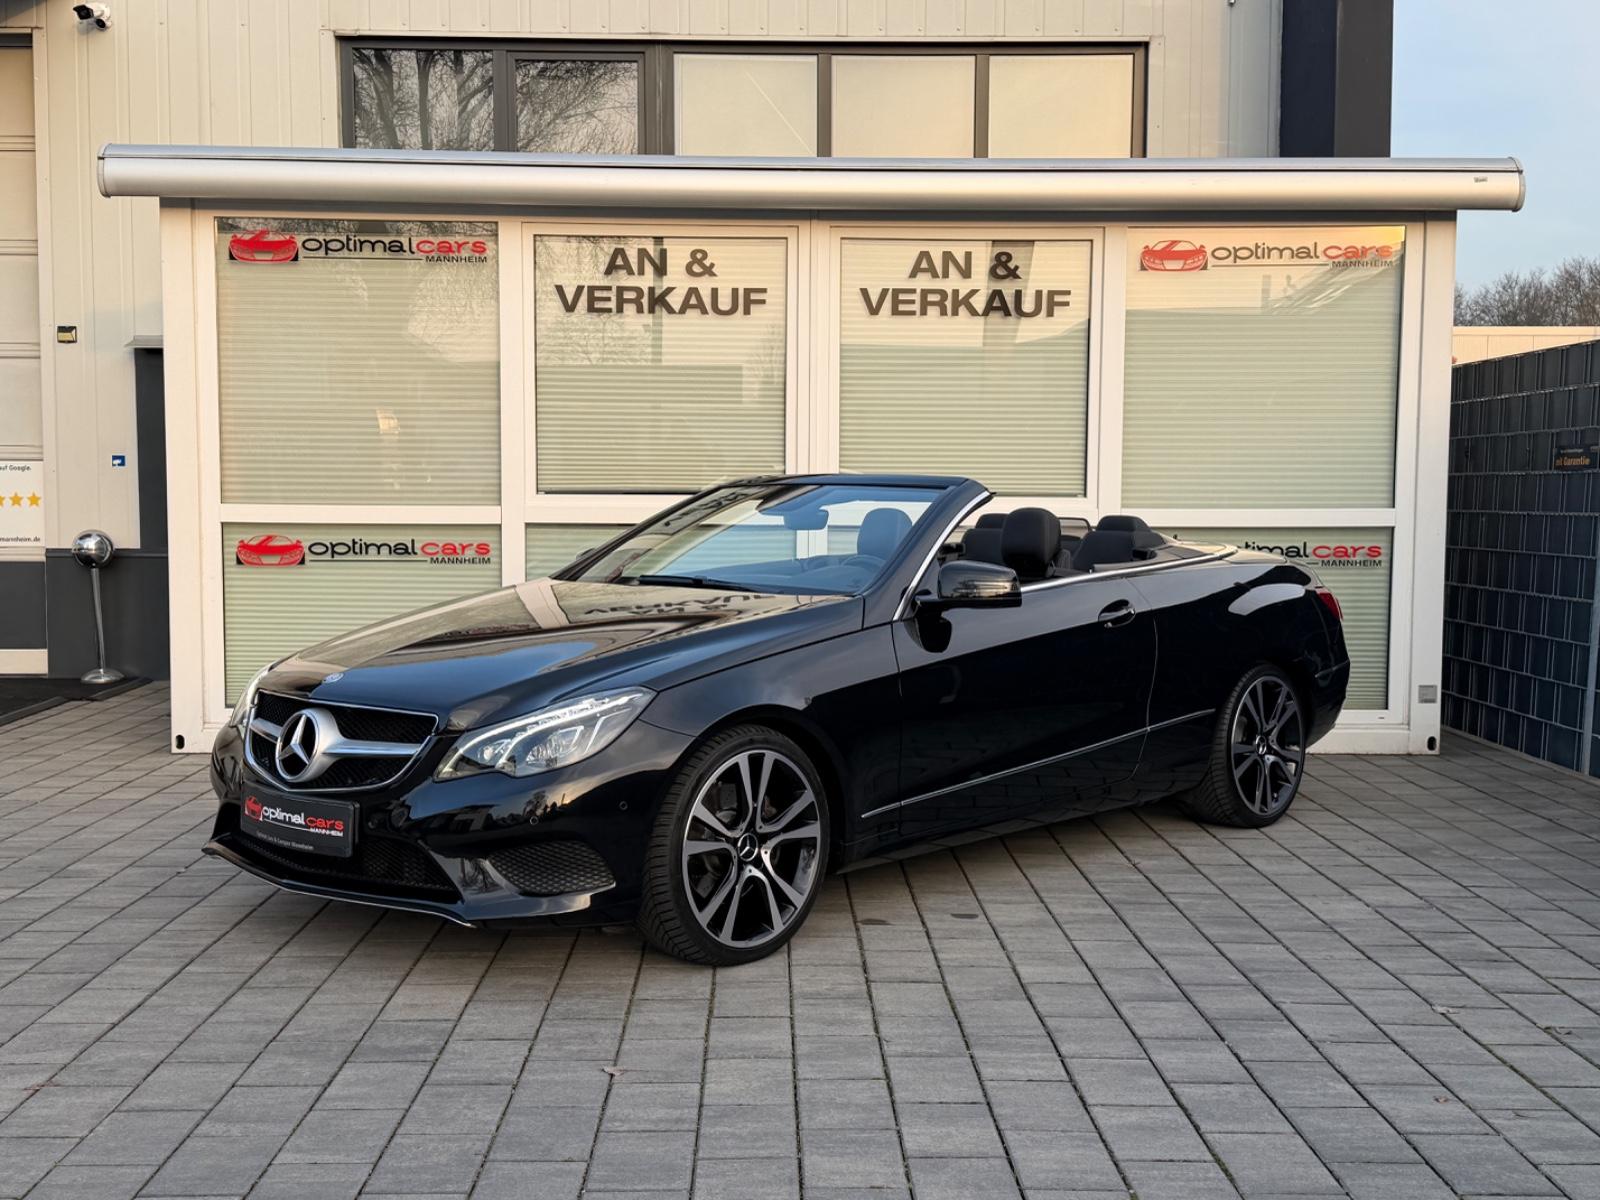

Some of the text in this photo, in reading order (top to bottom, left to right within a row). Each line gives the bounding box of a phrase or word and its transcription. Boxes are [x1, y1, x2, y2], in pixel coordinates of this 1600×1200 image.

[425, 255, 488, 263] MANNHEIM
[603, 247, 718, 278] AN &
[908, 250, 1022, 280] AN &
[1331, 260, 1394, 268] MANNHEIM
[554, 284, 768, 316] VERKAUF
[859, 287, 1072, 318] VERKAUF
[430, 557, 491, 565] MANNHEIM
[1320, 559, 1382, 567] MANNHEIM
